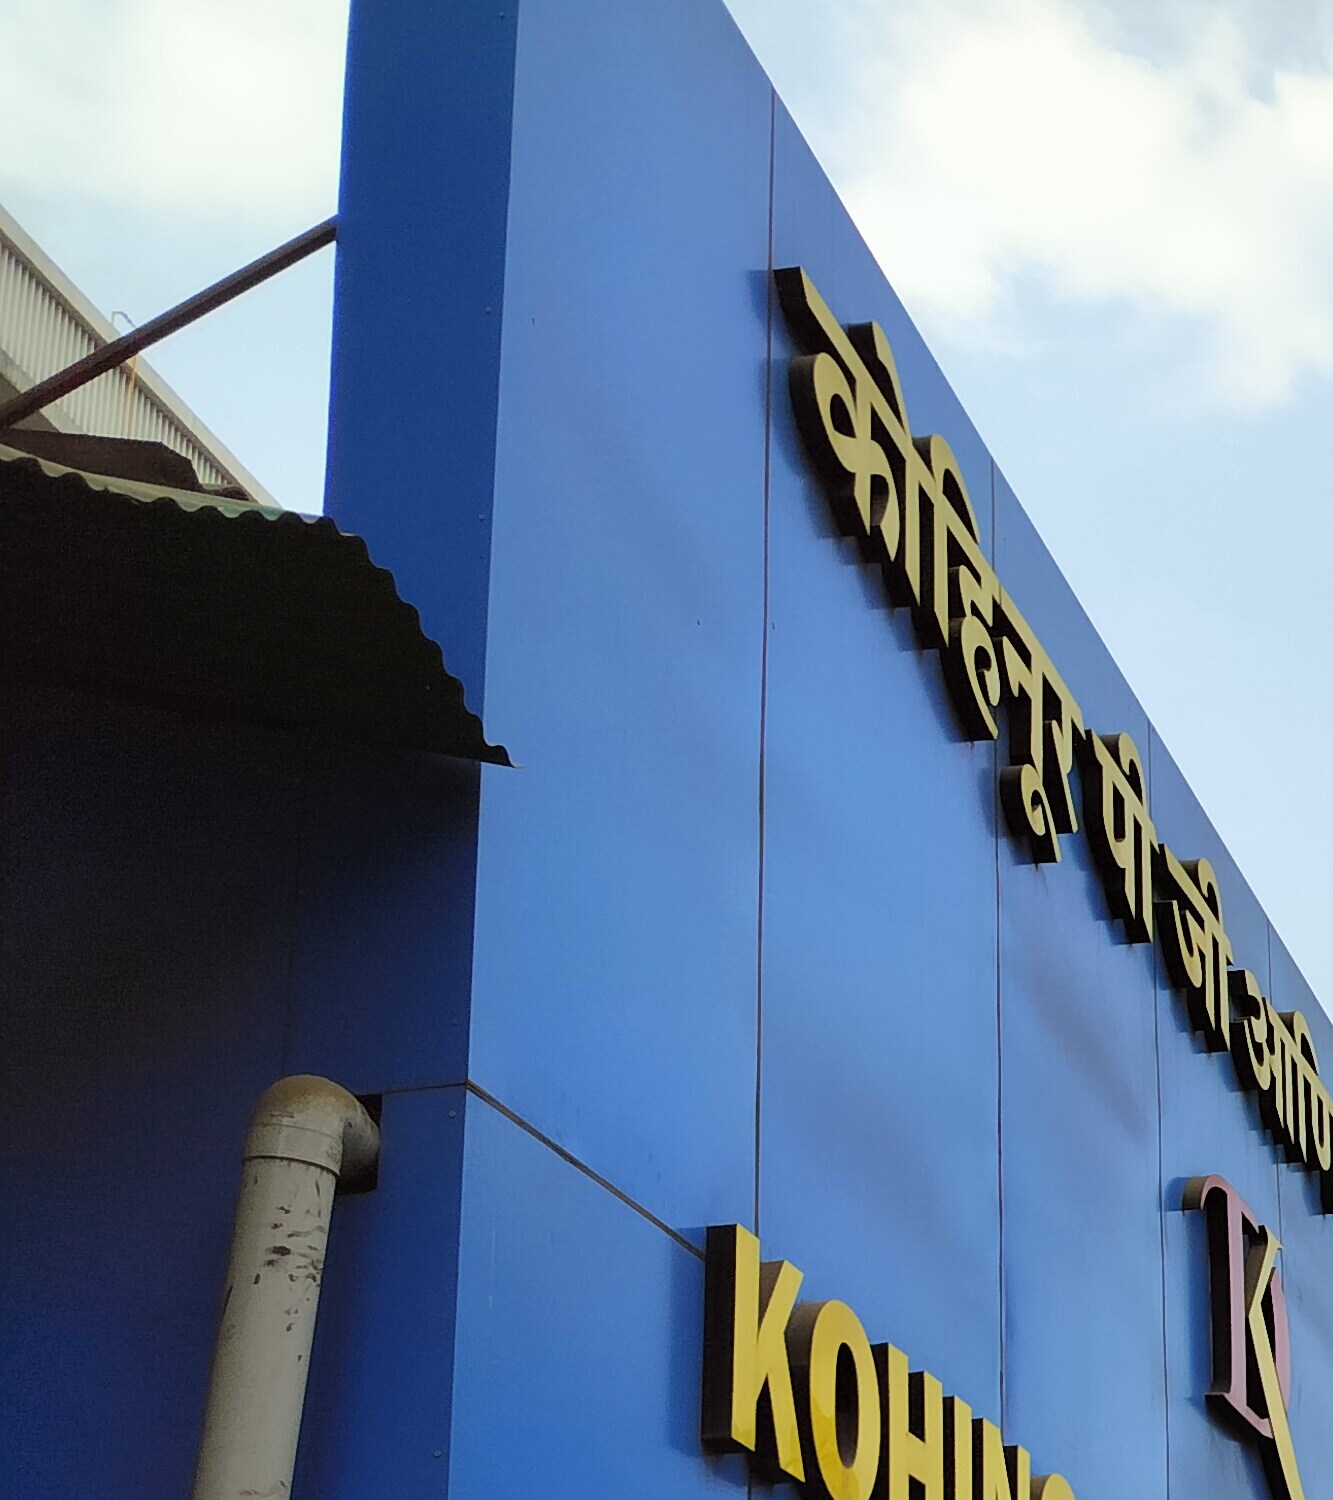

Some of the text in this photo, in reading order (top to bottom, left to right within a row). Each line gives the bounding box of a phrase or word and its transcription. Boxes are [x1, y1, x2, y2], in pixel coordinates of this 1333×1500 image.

[793, 266, 1087, 864] कोहिनूर
[1088, 728, 1160, 943] पी
[1162, 842, 1235, 1052] जी
